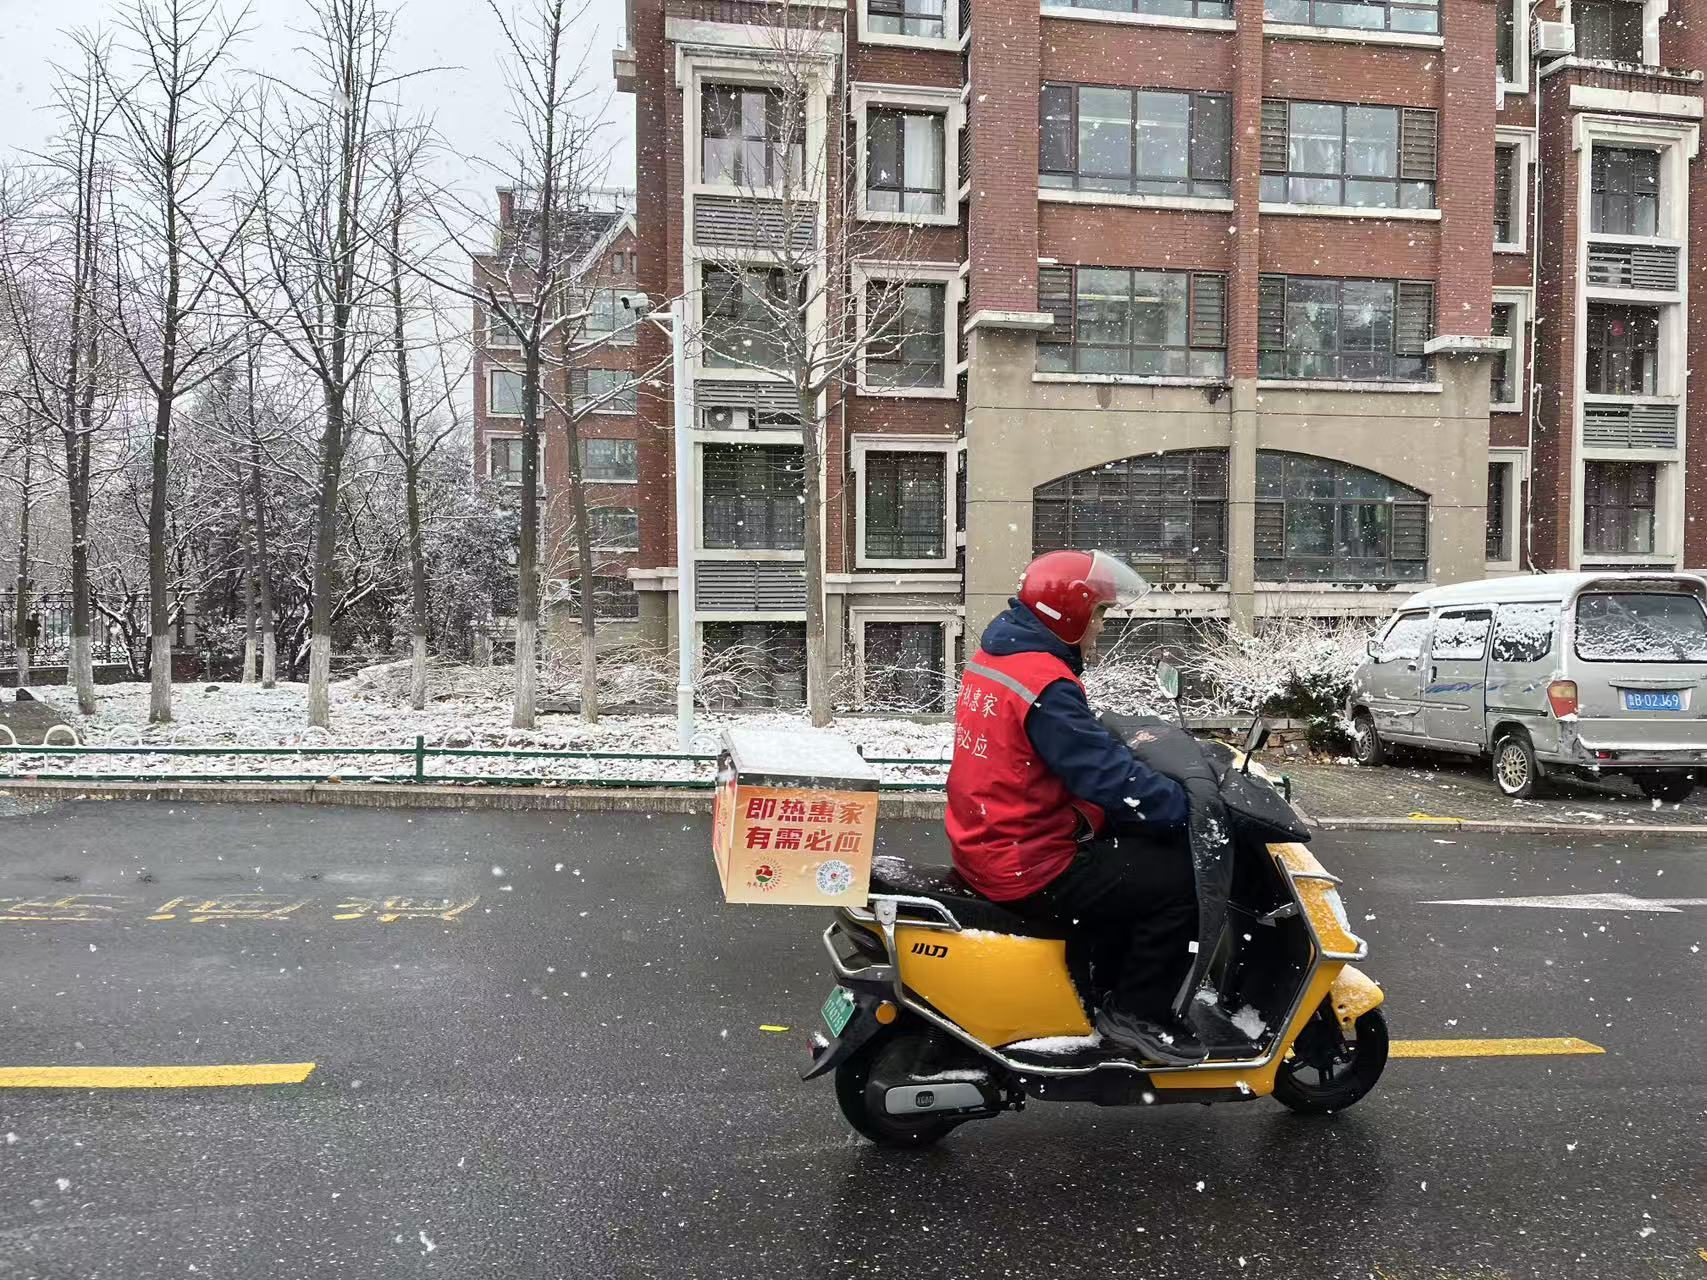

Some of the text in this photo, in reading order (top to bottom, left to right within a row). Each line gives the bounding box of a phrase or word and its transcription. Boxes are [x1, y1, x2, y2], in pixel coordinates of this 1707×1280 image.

[746, 798, 864, 824] 即热惠家
[745, 826, 862, 852] 有需必应
